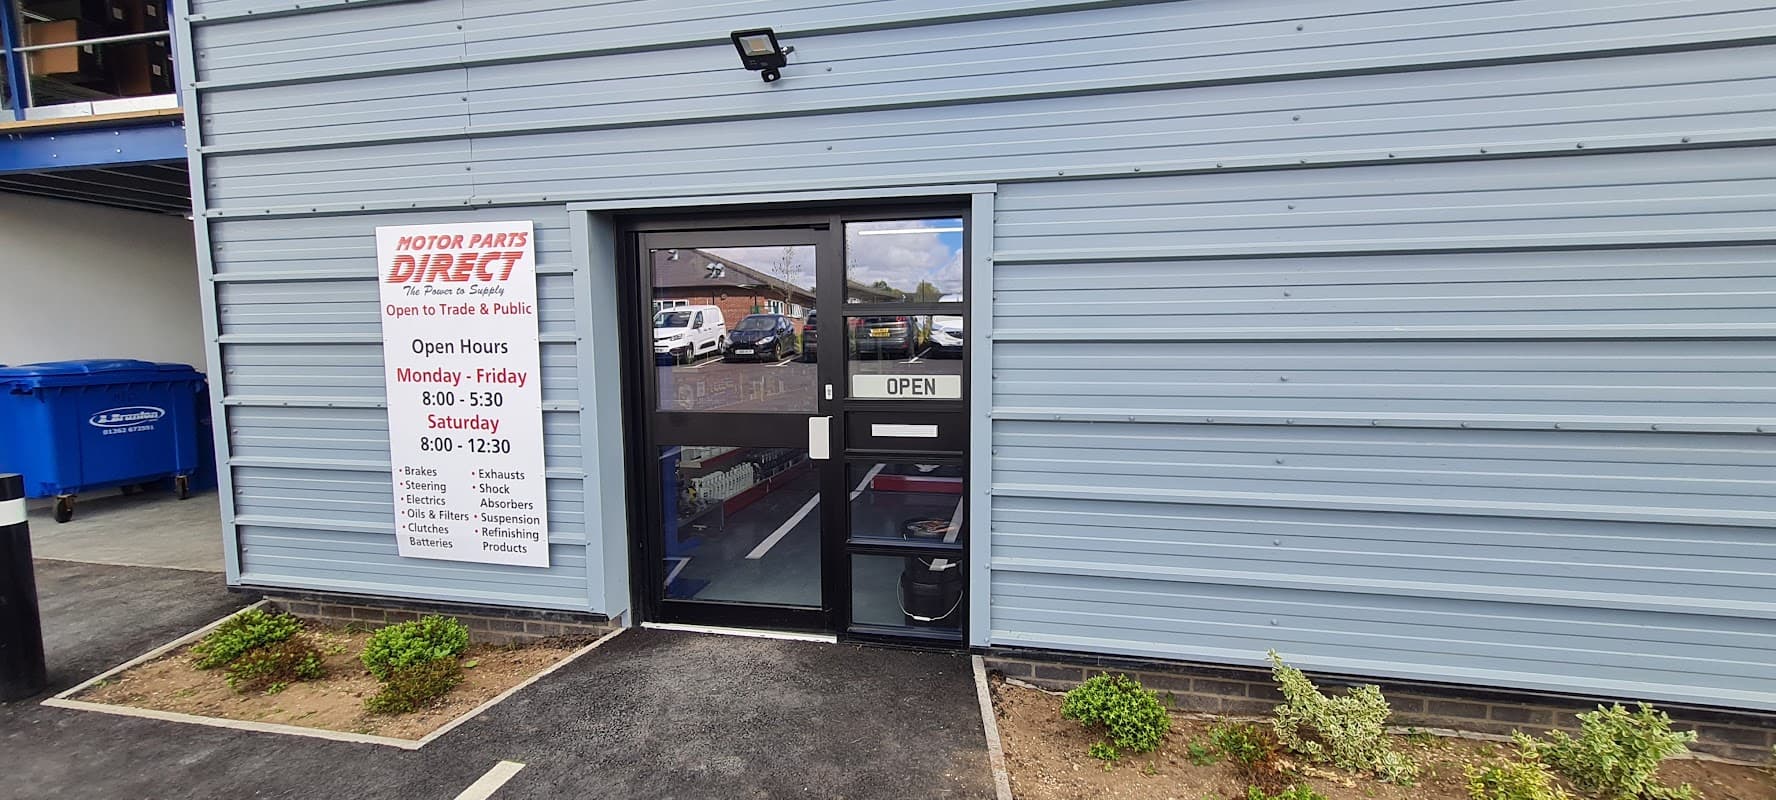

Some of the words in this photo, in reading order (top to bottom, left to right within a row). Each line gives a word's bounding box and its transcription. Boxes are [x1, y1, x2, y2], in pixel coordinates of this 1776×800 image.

[396, 234, 464, 250] MOTOR
[468, 232, 528, 248] PARTS
[385, 251, 523, 283] DIRECT
[403, 286, 420, 296] The
[424, 285, 452, 296] Power
[456, 286, 465, 295] to
[469, 284, 504, 296] Supply
[386, 305, 419, 318] Open
[423, 305, 435, 315] to
[439, 304, 475, 315] Trade
[480, 303, 488, 314] &
[494, 302, 532, 314] Public
[412, 339, 453, 357] Open
[460, 339, 508, 354] Hours
[397, 368, 461, 386] Monday
[476, 368, 527, 388] Friday
[887, 378, 936, 395] OPEN
[422, 391, 454, 406] 8:00
[470, 392, 503, 407] 5:30
[428, 414, 499, 434] Saturday
[420, 437, 452, 451] 8:00
[468, 439, 510, 454] 12:30
[404, 466, 437, 476] Brakes
[478, 469, 525, 480] Exhausts
[406, 481, 447, 493] Steering
[479, 484, 510, 494] Shock
[406, 495, 446, 505] Electrics
[480, 498, 534, 510] Absorbers
[407, 509, 425, 519] Oils
[429, 510, 436, 519] &
[439, 511, 469, 521] Filters
[481, 513, 540, 525] Suspension
[408, 523, 449, 534] Clutches
[482, 527, 539, 541] Refinishing
[410, 537, 453, 548] Batteries
[483, 542, 527, 553] Products
